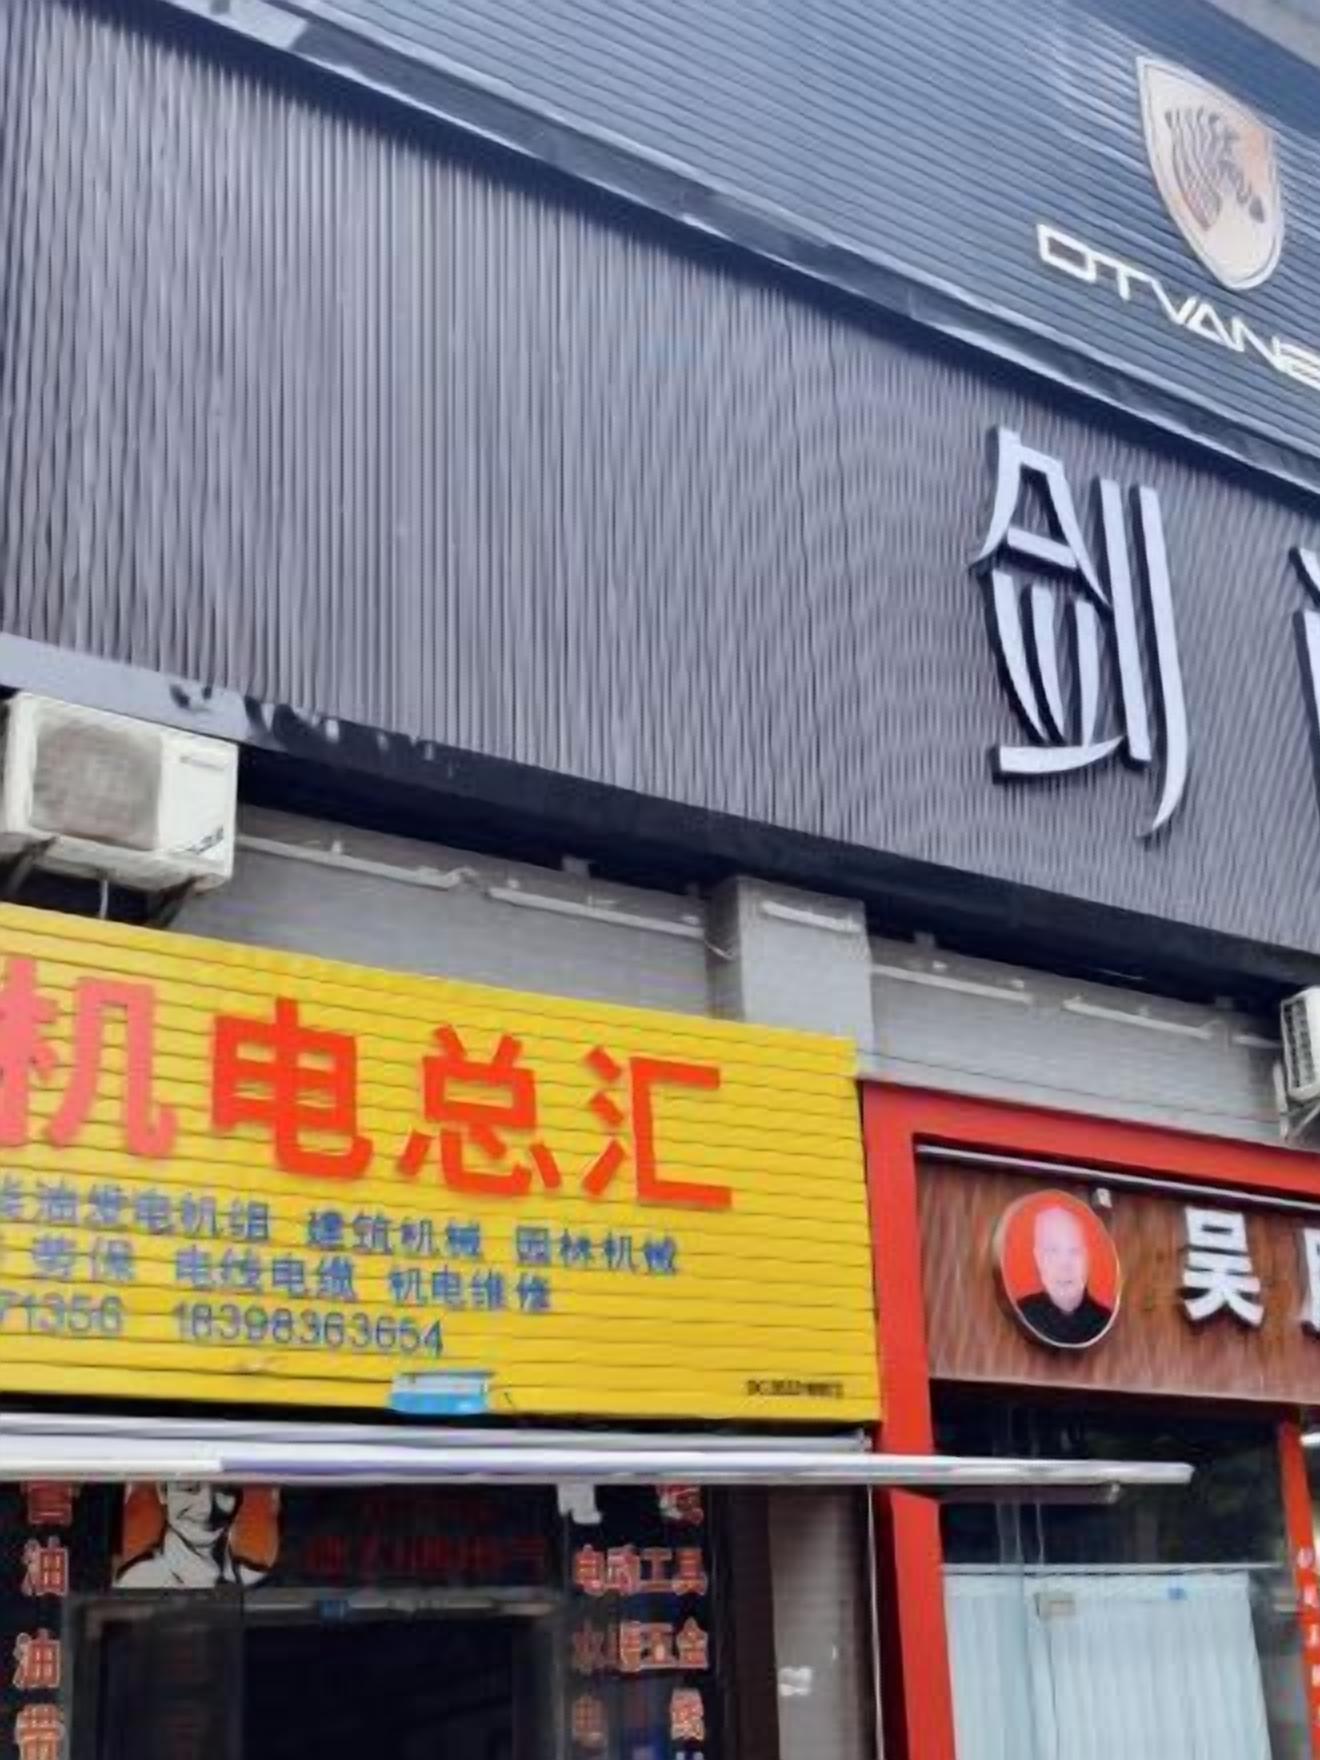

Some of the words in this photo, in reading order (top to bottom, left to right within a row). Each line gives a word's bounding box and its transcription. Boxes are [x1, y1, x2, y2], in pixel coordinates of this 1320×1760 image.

[0, 955, 733, 1212] 机电总汇
[307, 1208, 484, 1260] 建筑机械
[516, 1225, 679, 1275] 园林机械
[174, 1244, 356, 1304] 电线电缆
[388, 1264, 551, 1314] 机电维修
[573, 1544, 708, 1597] 电动工具
